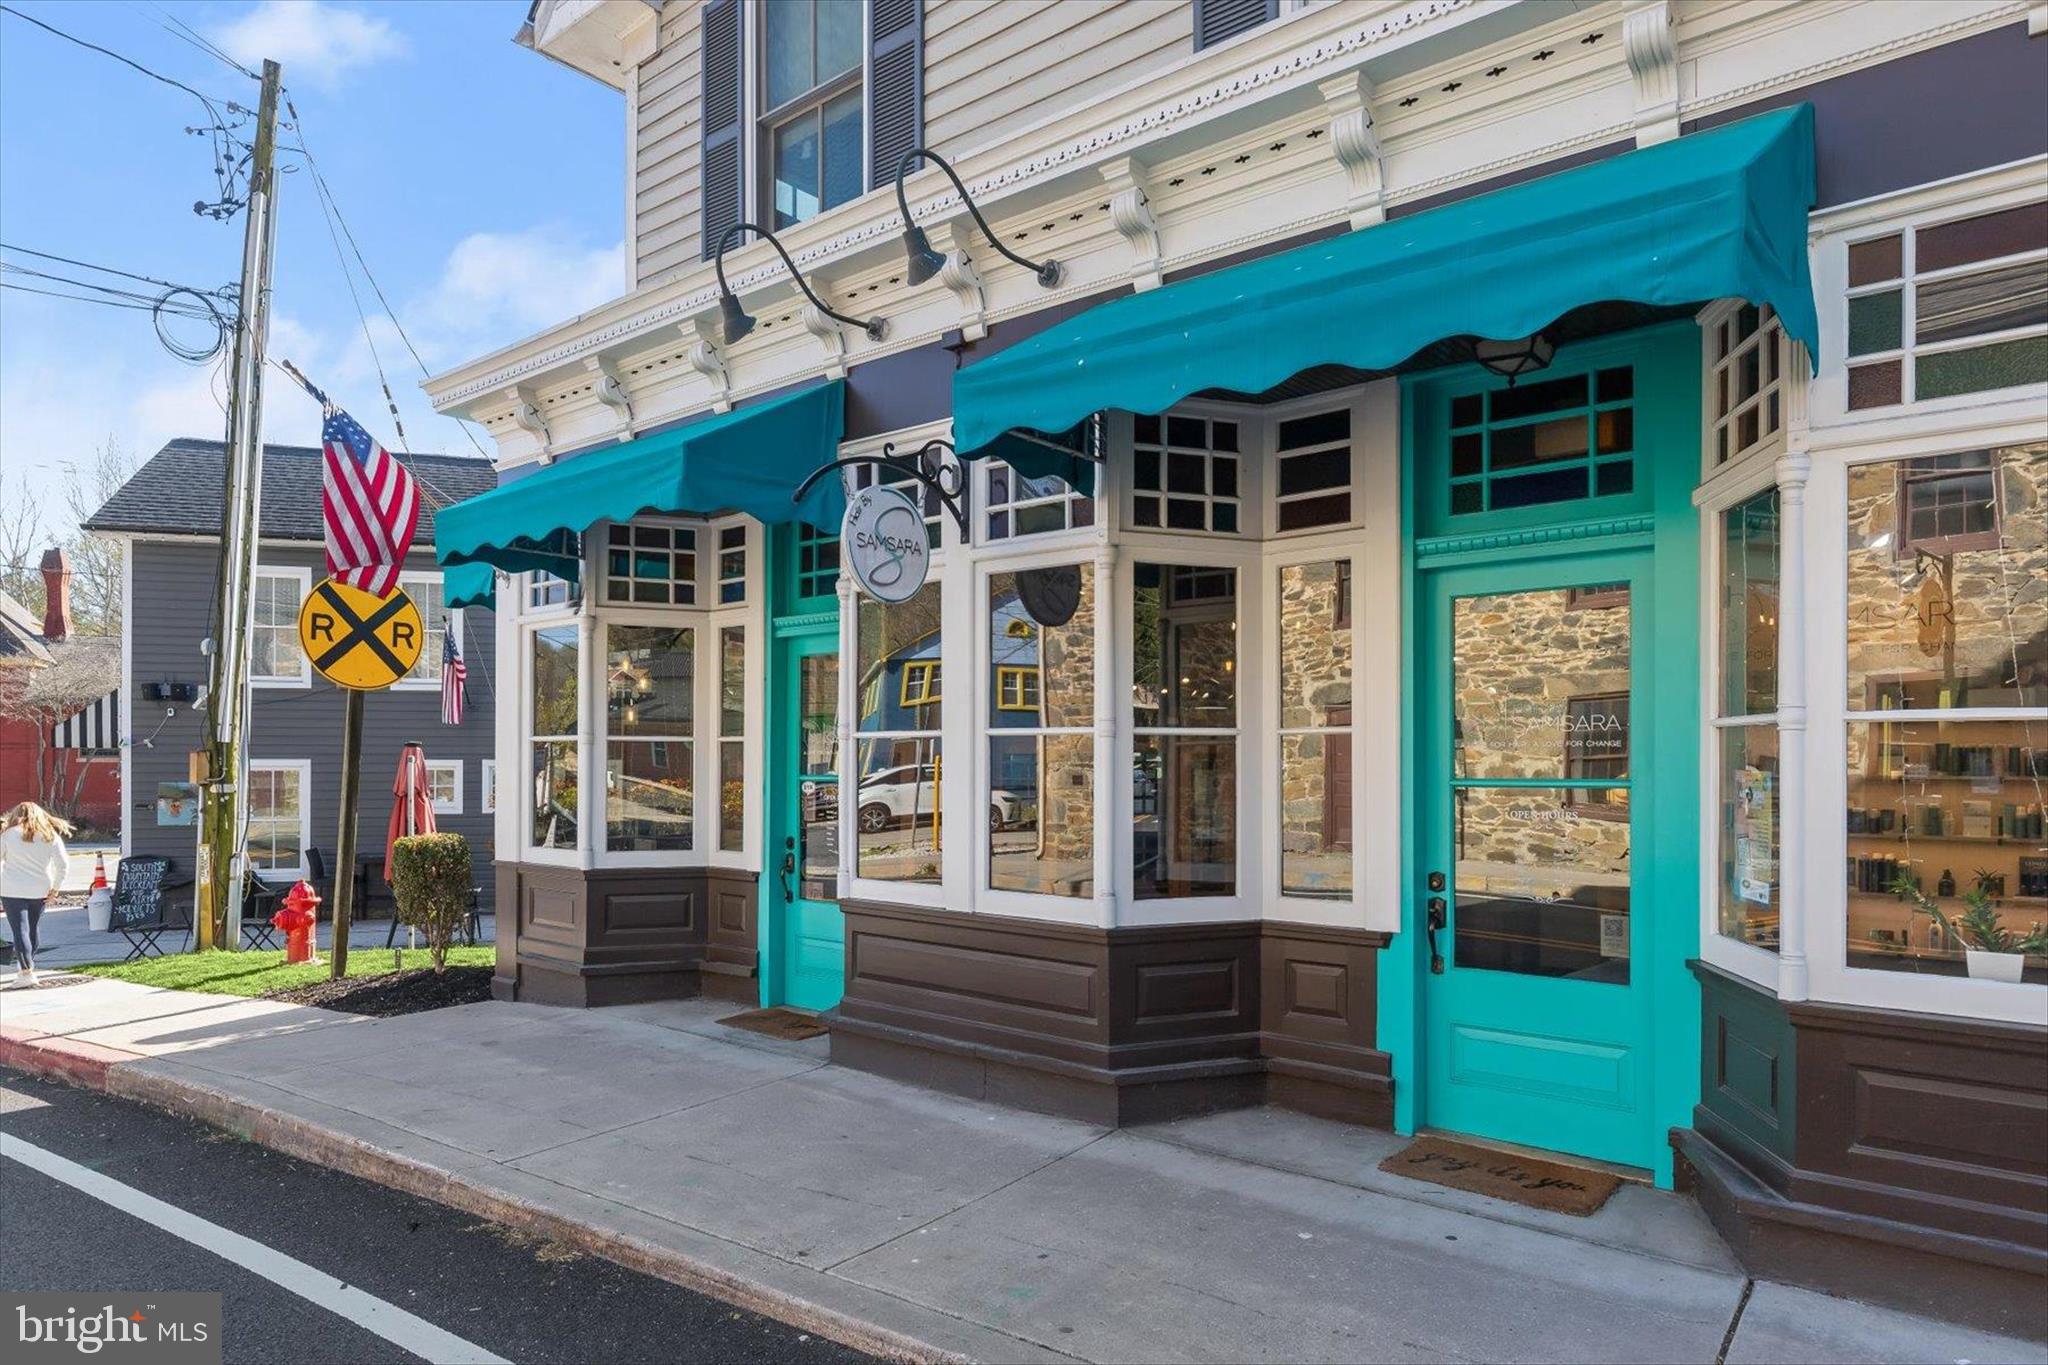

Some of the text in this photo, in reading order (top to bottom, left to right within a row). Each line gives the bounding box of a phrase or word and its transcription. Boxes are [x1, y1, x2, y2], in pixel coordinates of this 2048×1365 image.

[856, 532, 922, 556] SAMSARA
[310, 612, 415, 650] R R
[1512, 714, 1623, 735] SAMSARA
[1585, 739, 1622, 748] CHANGE
[1510, 810, 1579, 821] OPEN HOURS
